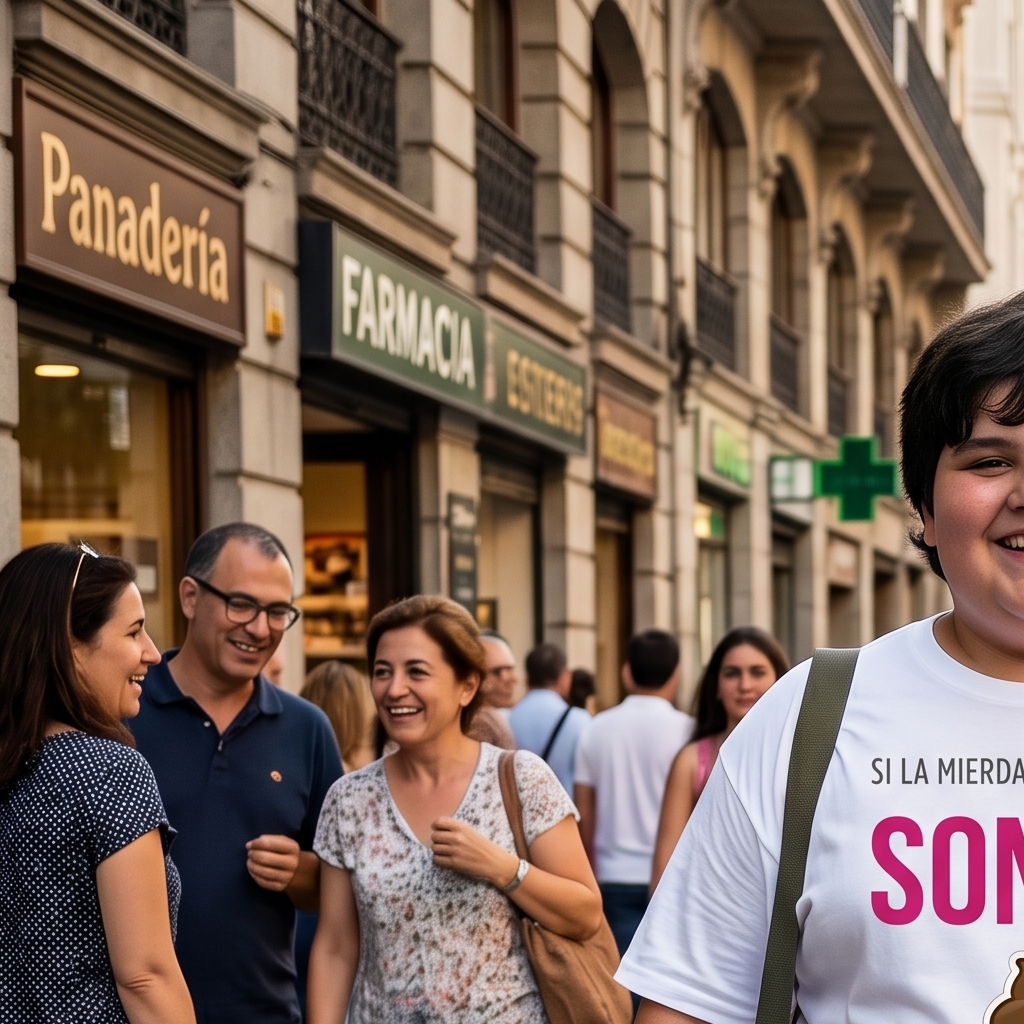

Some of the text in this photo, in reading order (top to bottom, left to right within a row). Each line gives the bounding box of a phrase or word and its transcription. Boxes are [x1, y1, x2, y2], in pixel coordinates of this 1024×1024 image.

[41, 131, 229, 304] Panadería
[342, 254, 476, 390] FARMACIA
[872, 758, 891, 784] SI
[902, 758, 929, 784] LA
